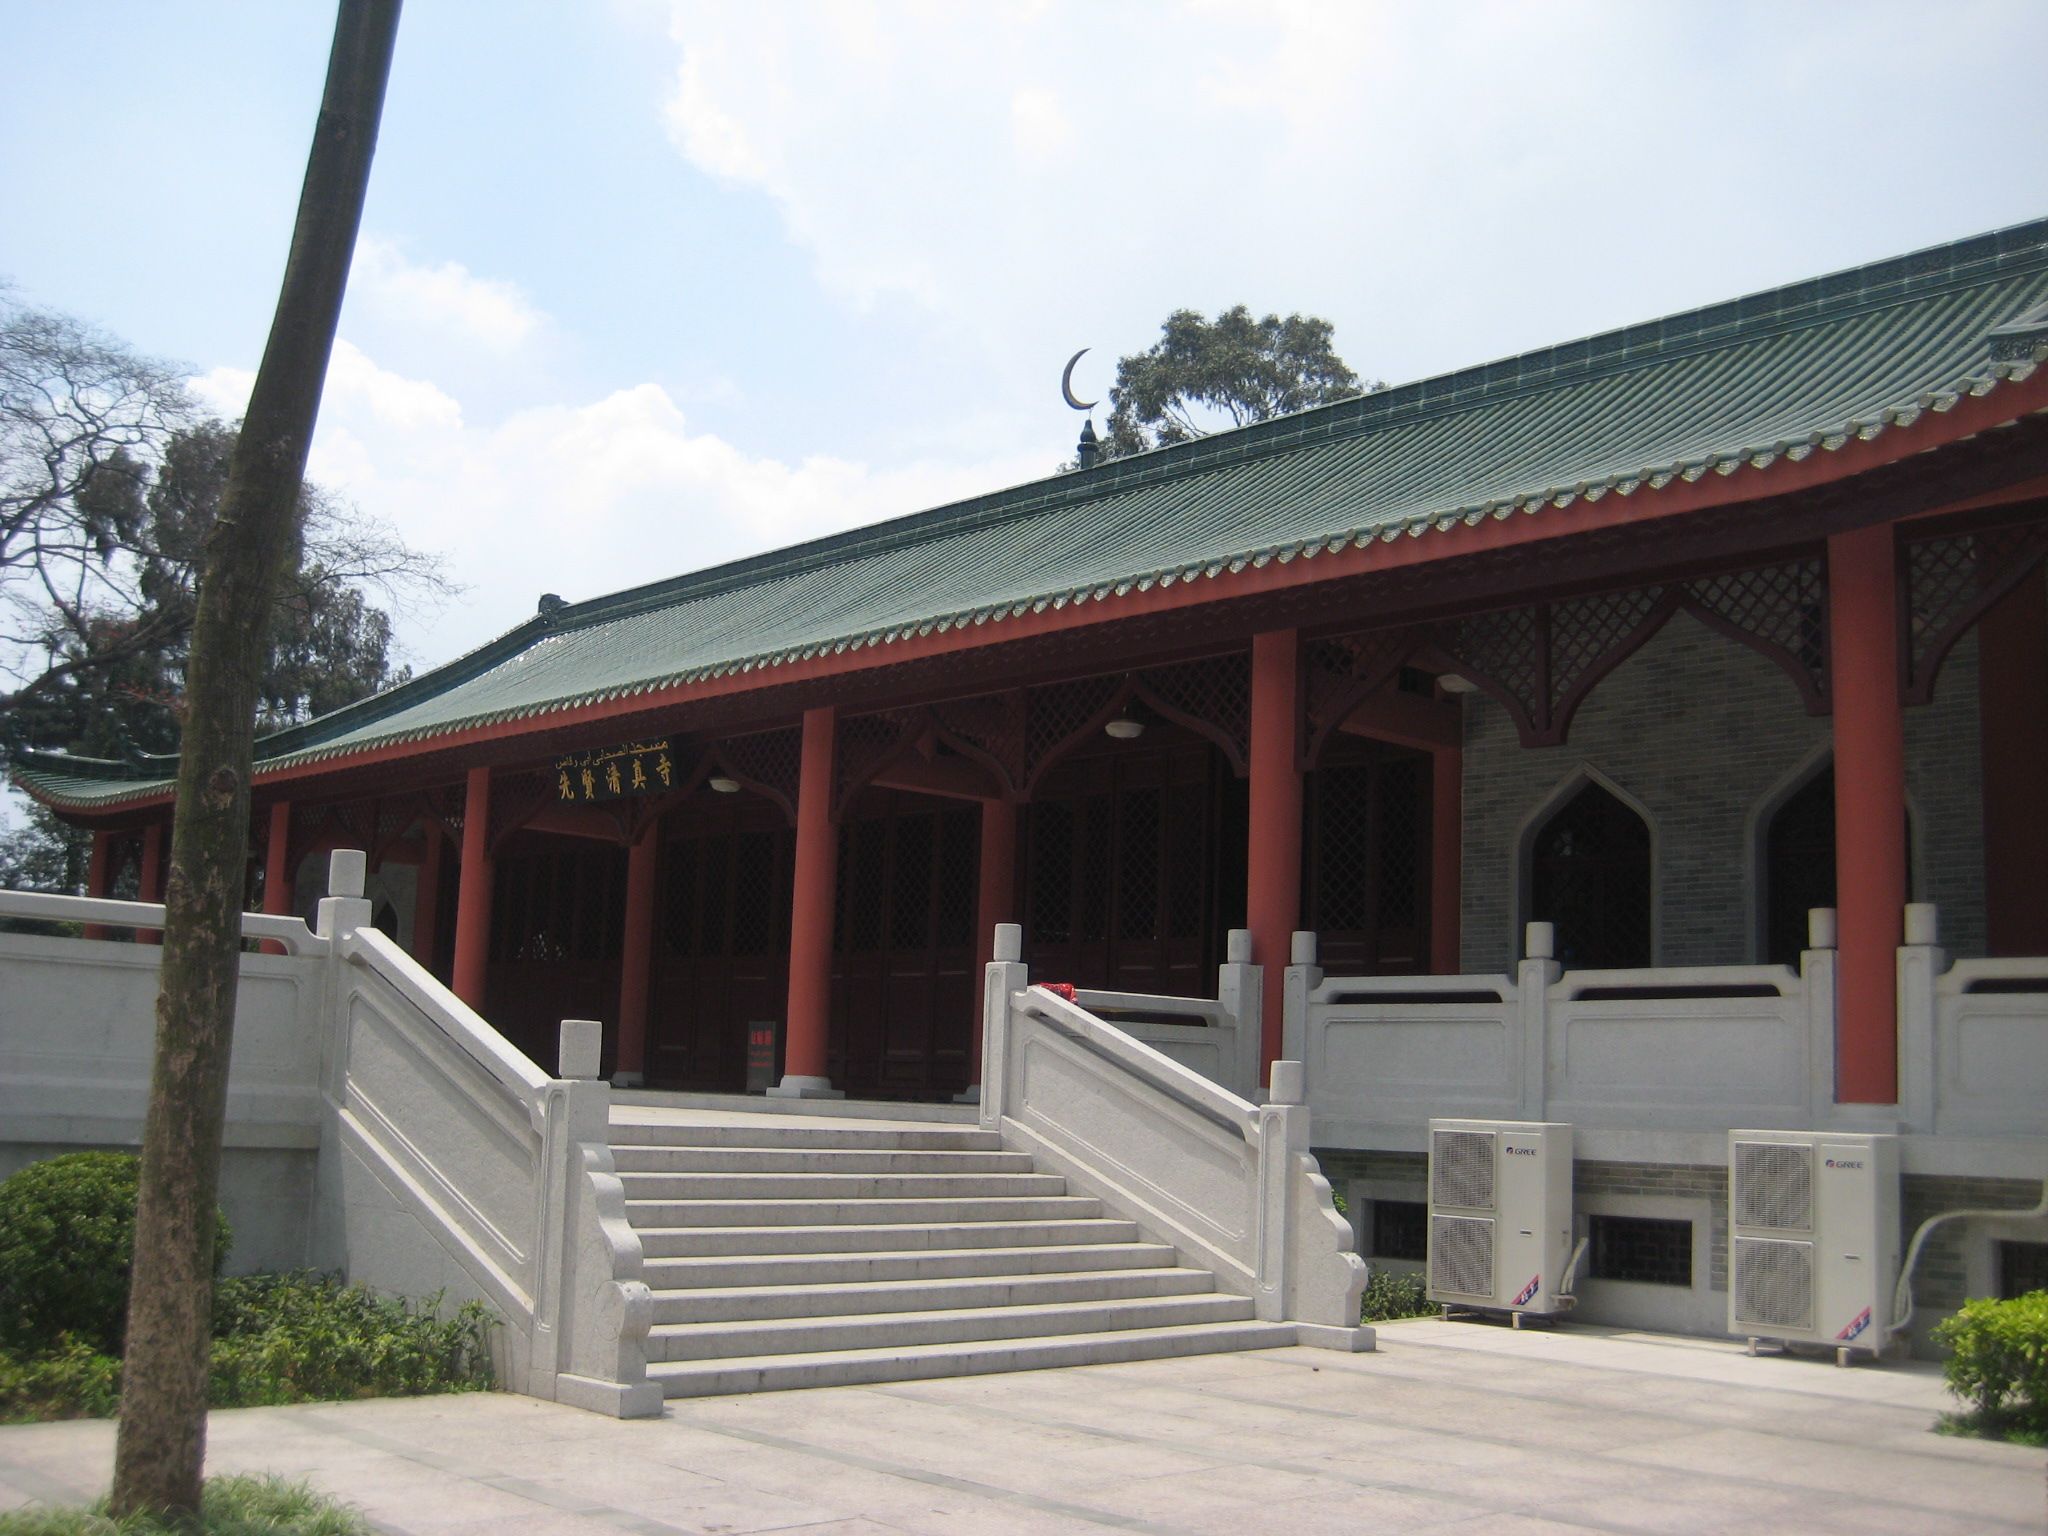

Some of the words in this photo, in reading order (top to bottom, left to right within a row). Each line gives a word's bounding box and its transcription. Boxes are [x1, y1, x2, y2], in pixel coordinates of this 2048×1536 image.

[558, 753, 672, 800] 先賢清真寺
[1515, 1148, 1537, 1156] GREE
[1836, 1160, 1864, 1169] GREE
